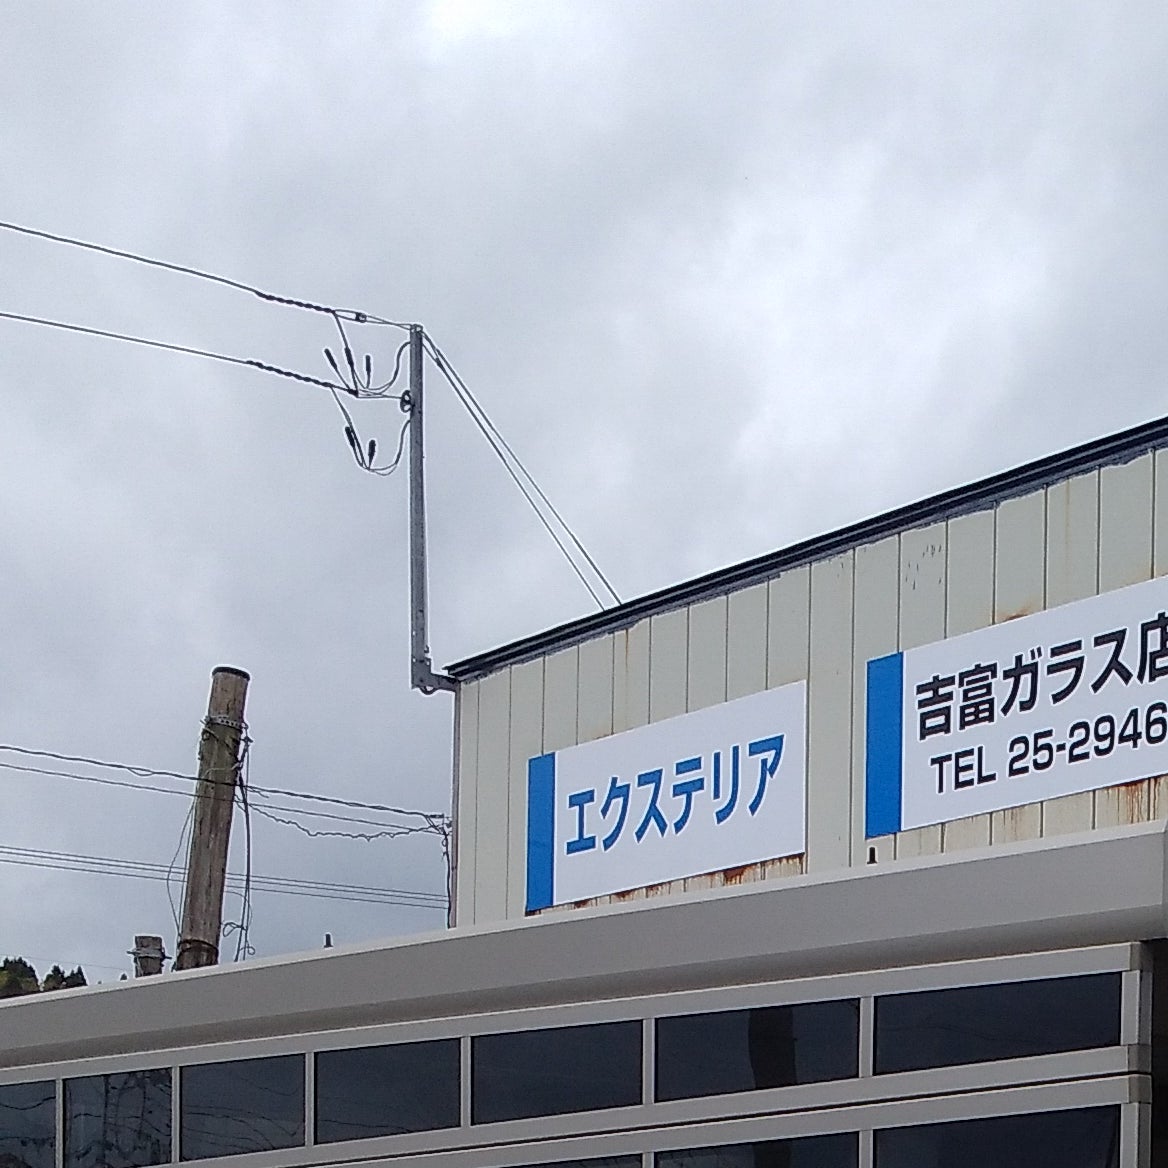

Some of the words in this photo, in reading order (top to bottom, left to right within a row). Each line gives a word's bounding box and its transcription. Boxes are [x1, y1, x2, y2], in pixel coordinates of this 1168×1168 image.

[565, 734, 785, 856] エクステリア
[931, 747, 996, 795] TEL
